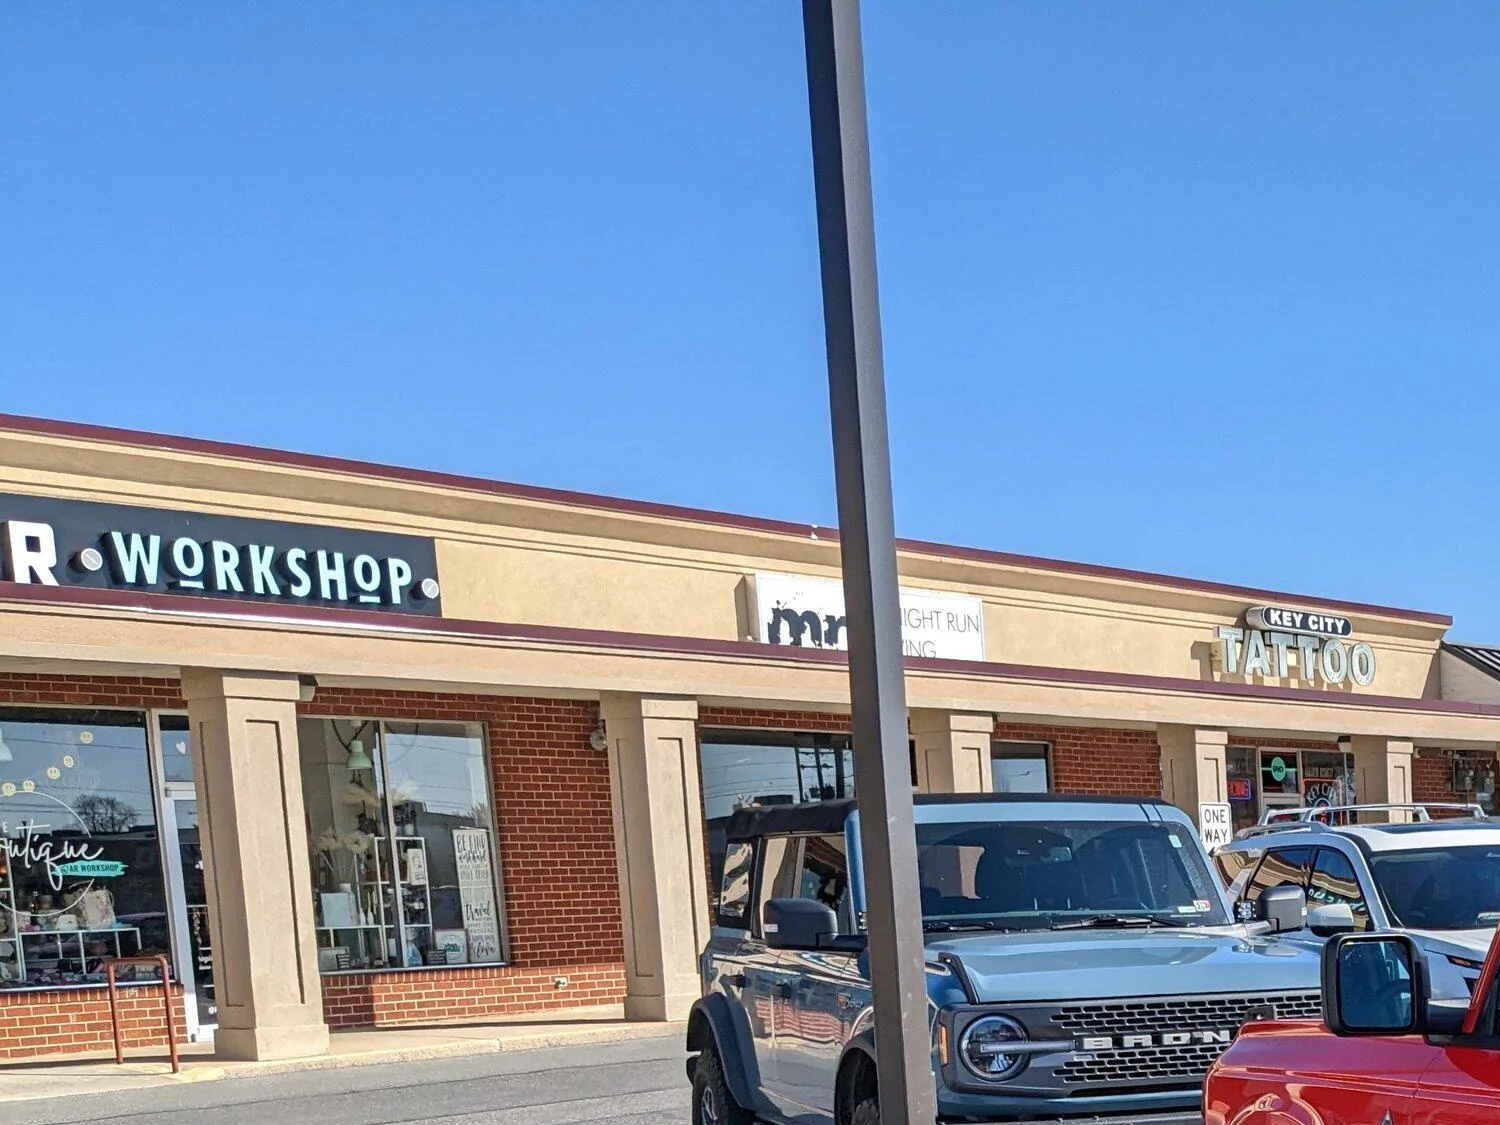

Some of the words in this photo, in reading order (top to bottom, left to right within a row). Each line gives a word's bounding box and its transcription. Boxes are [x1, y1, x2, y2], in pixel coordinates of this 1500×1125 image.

[111, 531, 412, 604] WORKSHOP
[903, 607, 942, 630] IGHT
[946, 611, 980, 634] RUN
[1269, 609, 1303, 628] KEY
[1308, 615, 1345, 634] CITY
[1218, 626, 1376, 687] TATTOO
[1204, 809, 1227, 823] ONE
[1204, 829, 1228, 843] WAY
[81, 864, 119, 873] WORKSHOP
[1083, 1030, 1230, 1049] BRON
